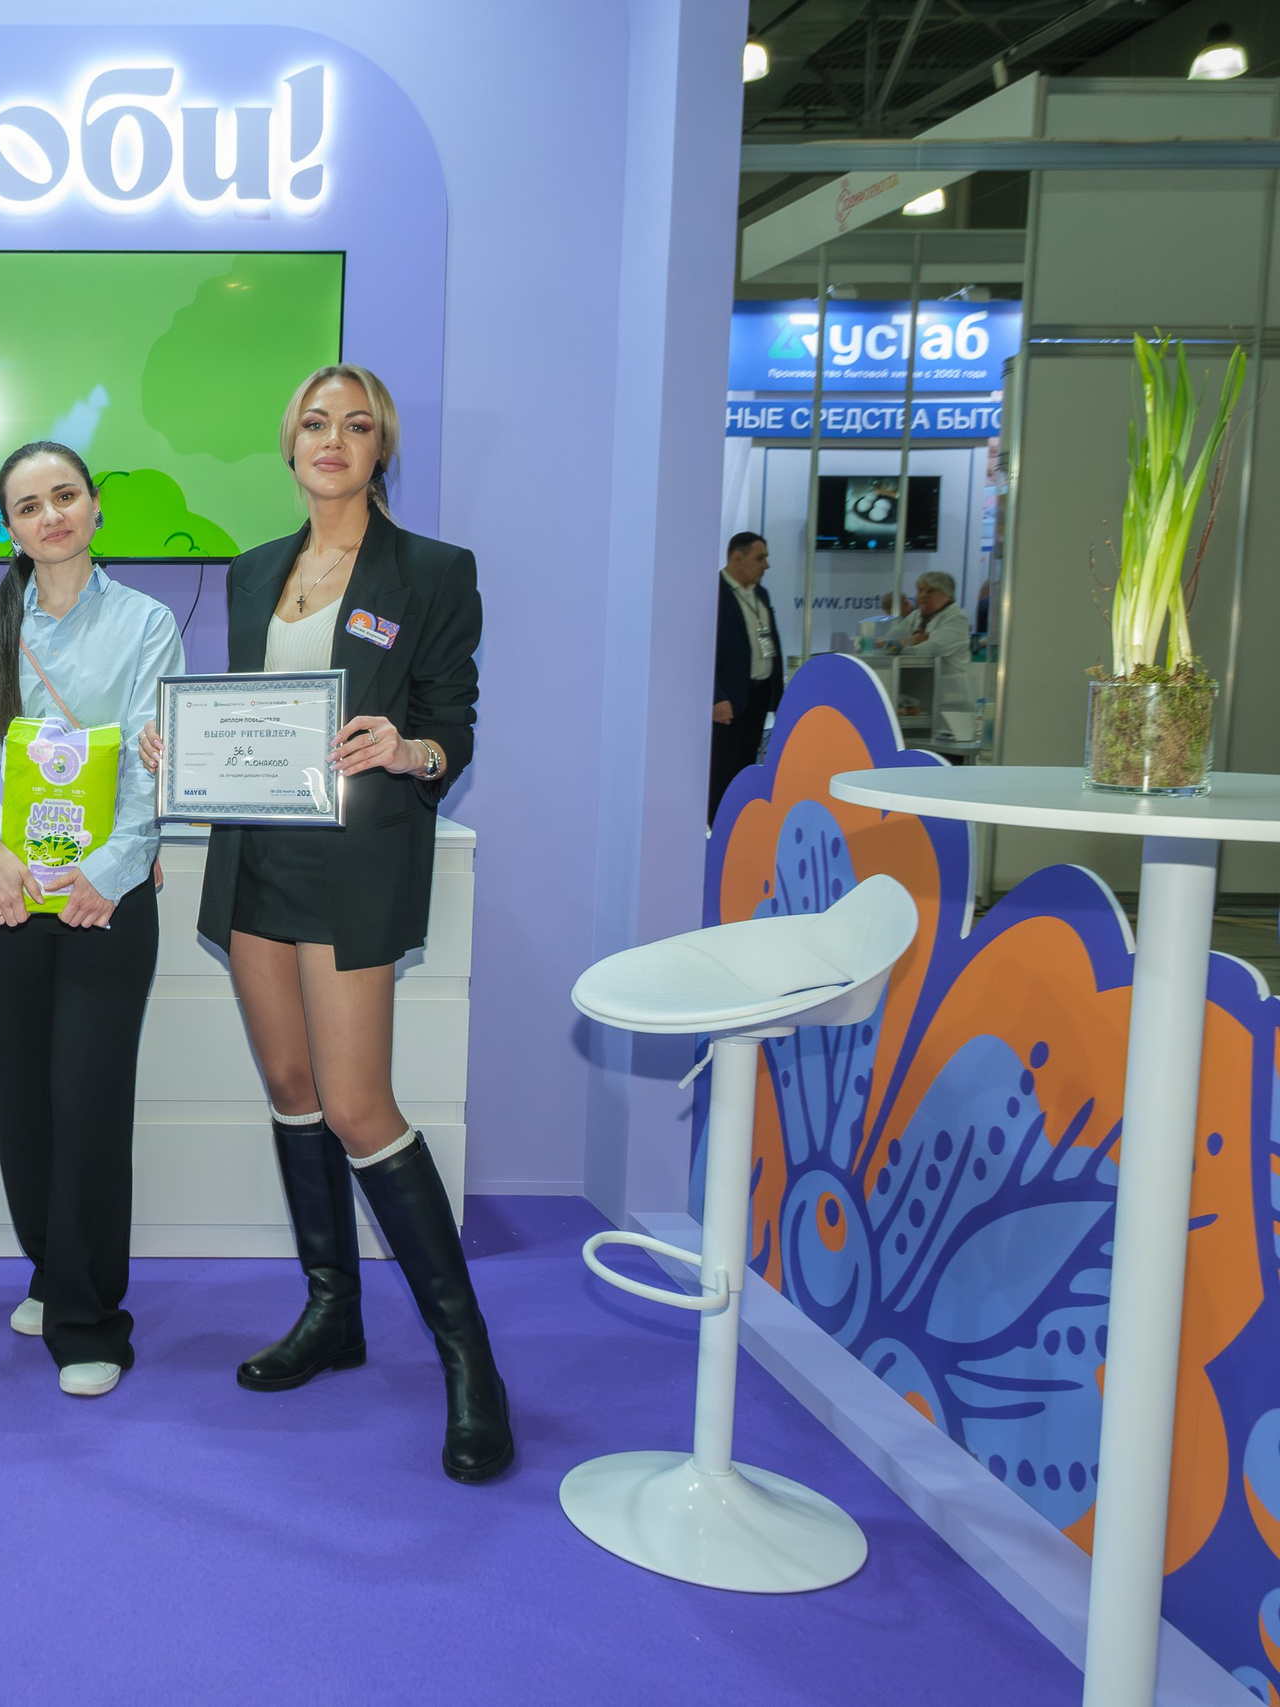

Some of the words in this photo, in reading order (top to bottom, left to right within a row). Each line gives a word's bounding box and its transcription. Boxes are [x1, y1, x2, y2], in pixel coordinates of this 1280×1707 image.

[932, 368, 962, 379] 2002
[204, 730, 237, 738] ВЫБОР
[240, 729, 297, 738] РИТЕЙЛЕРА
[233, 745, 254, 757] 36,6
[296, 789, 315, 797] 202
